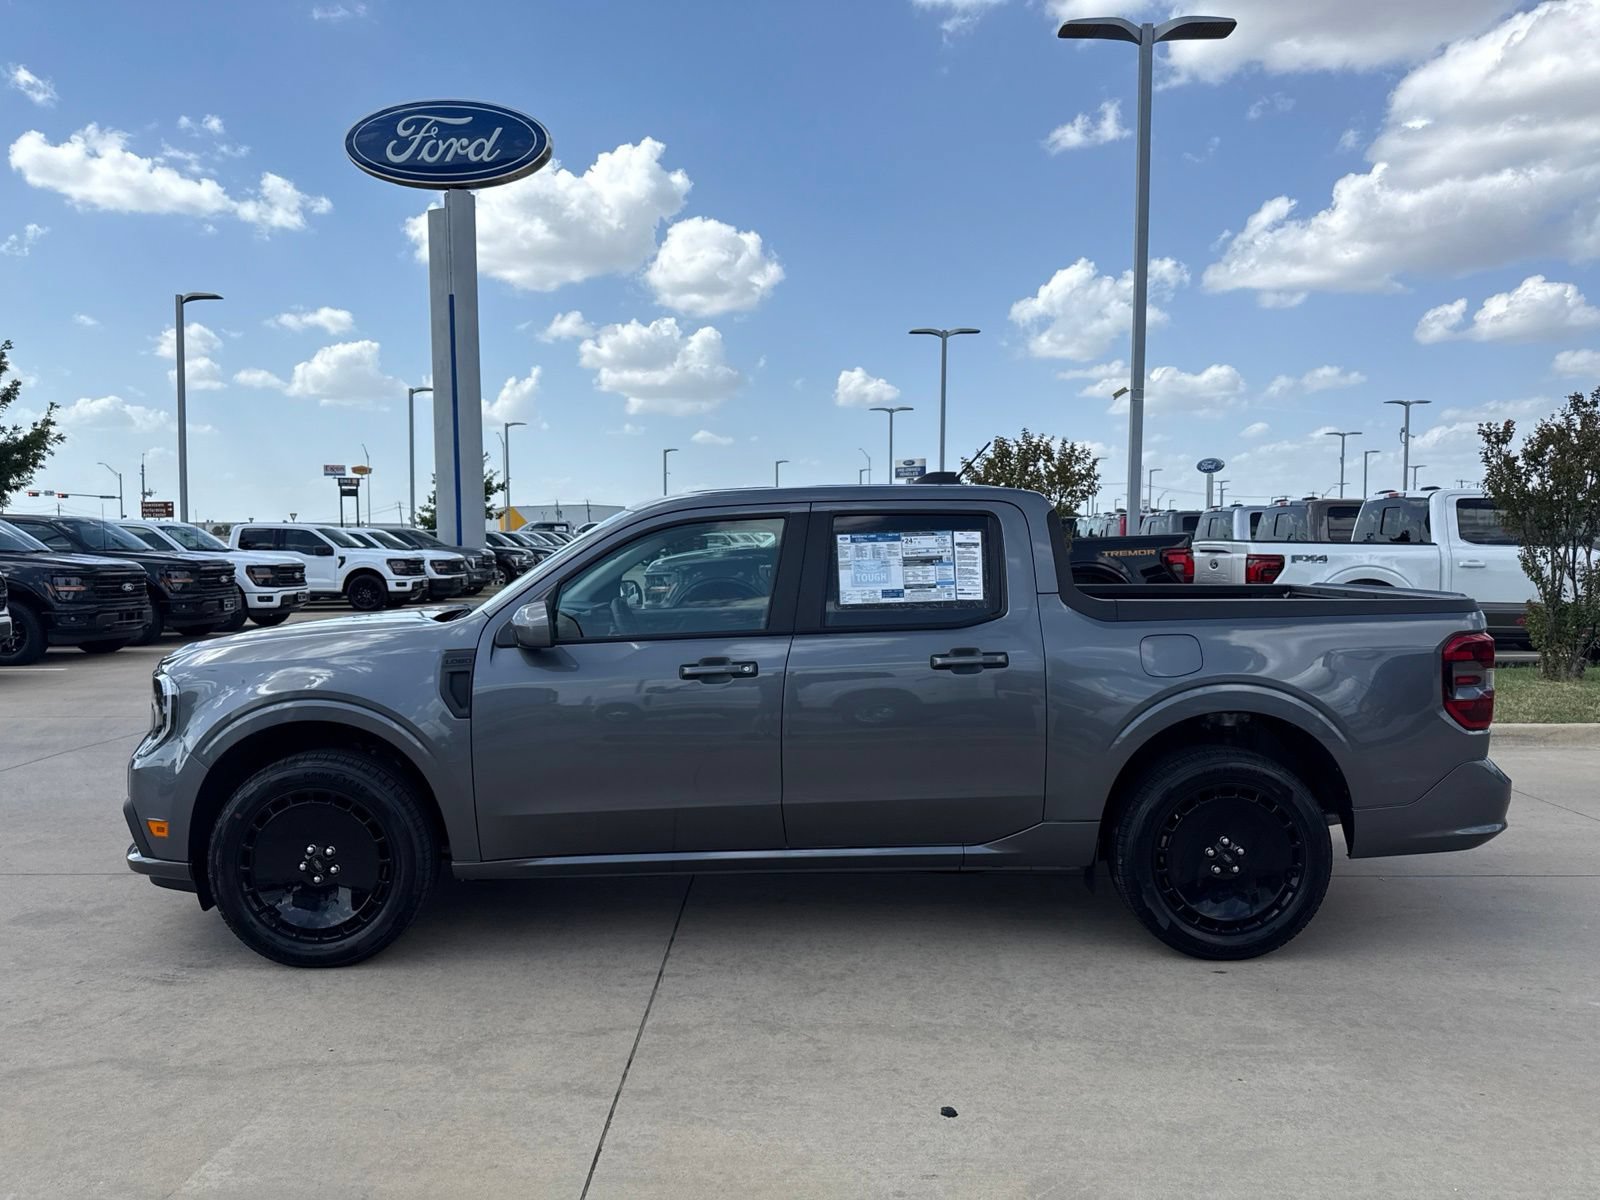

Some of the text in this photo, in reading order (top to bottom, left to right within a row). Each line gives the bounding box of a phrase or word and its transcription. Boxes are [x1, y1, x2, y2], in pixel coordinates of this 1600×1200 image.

[386, 115, 503, 163] Ford
[1102, 549, 1156, 557] TREMOR
[1291, 554, 1328, 564] FX4
[855, 572, 887, 582] TOUGH
